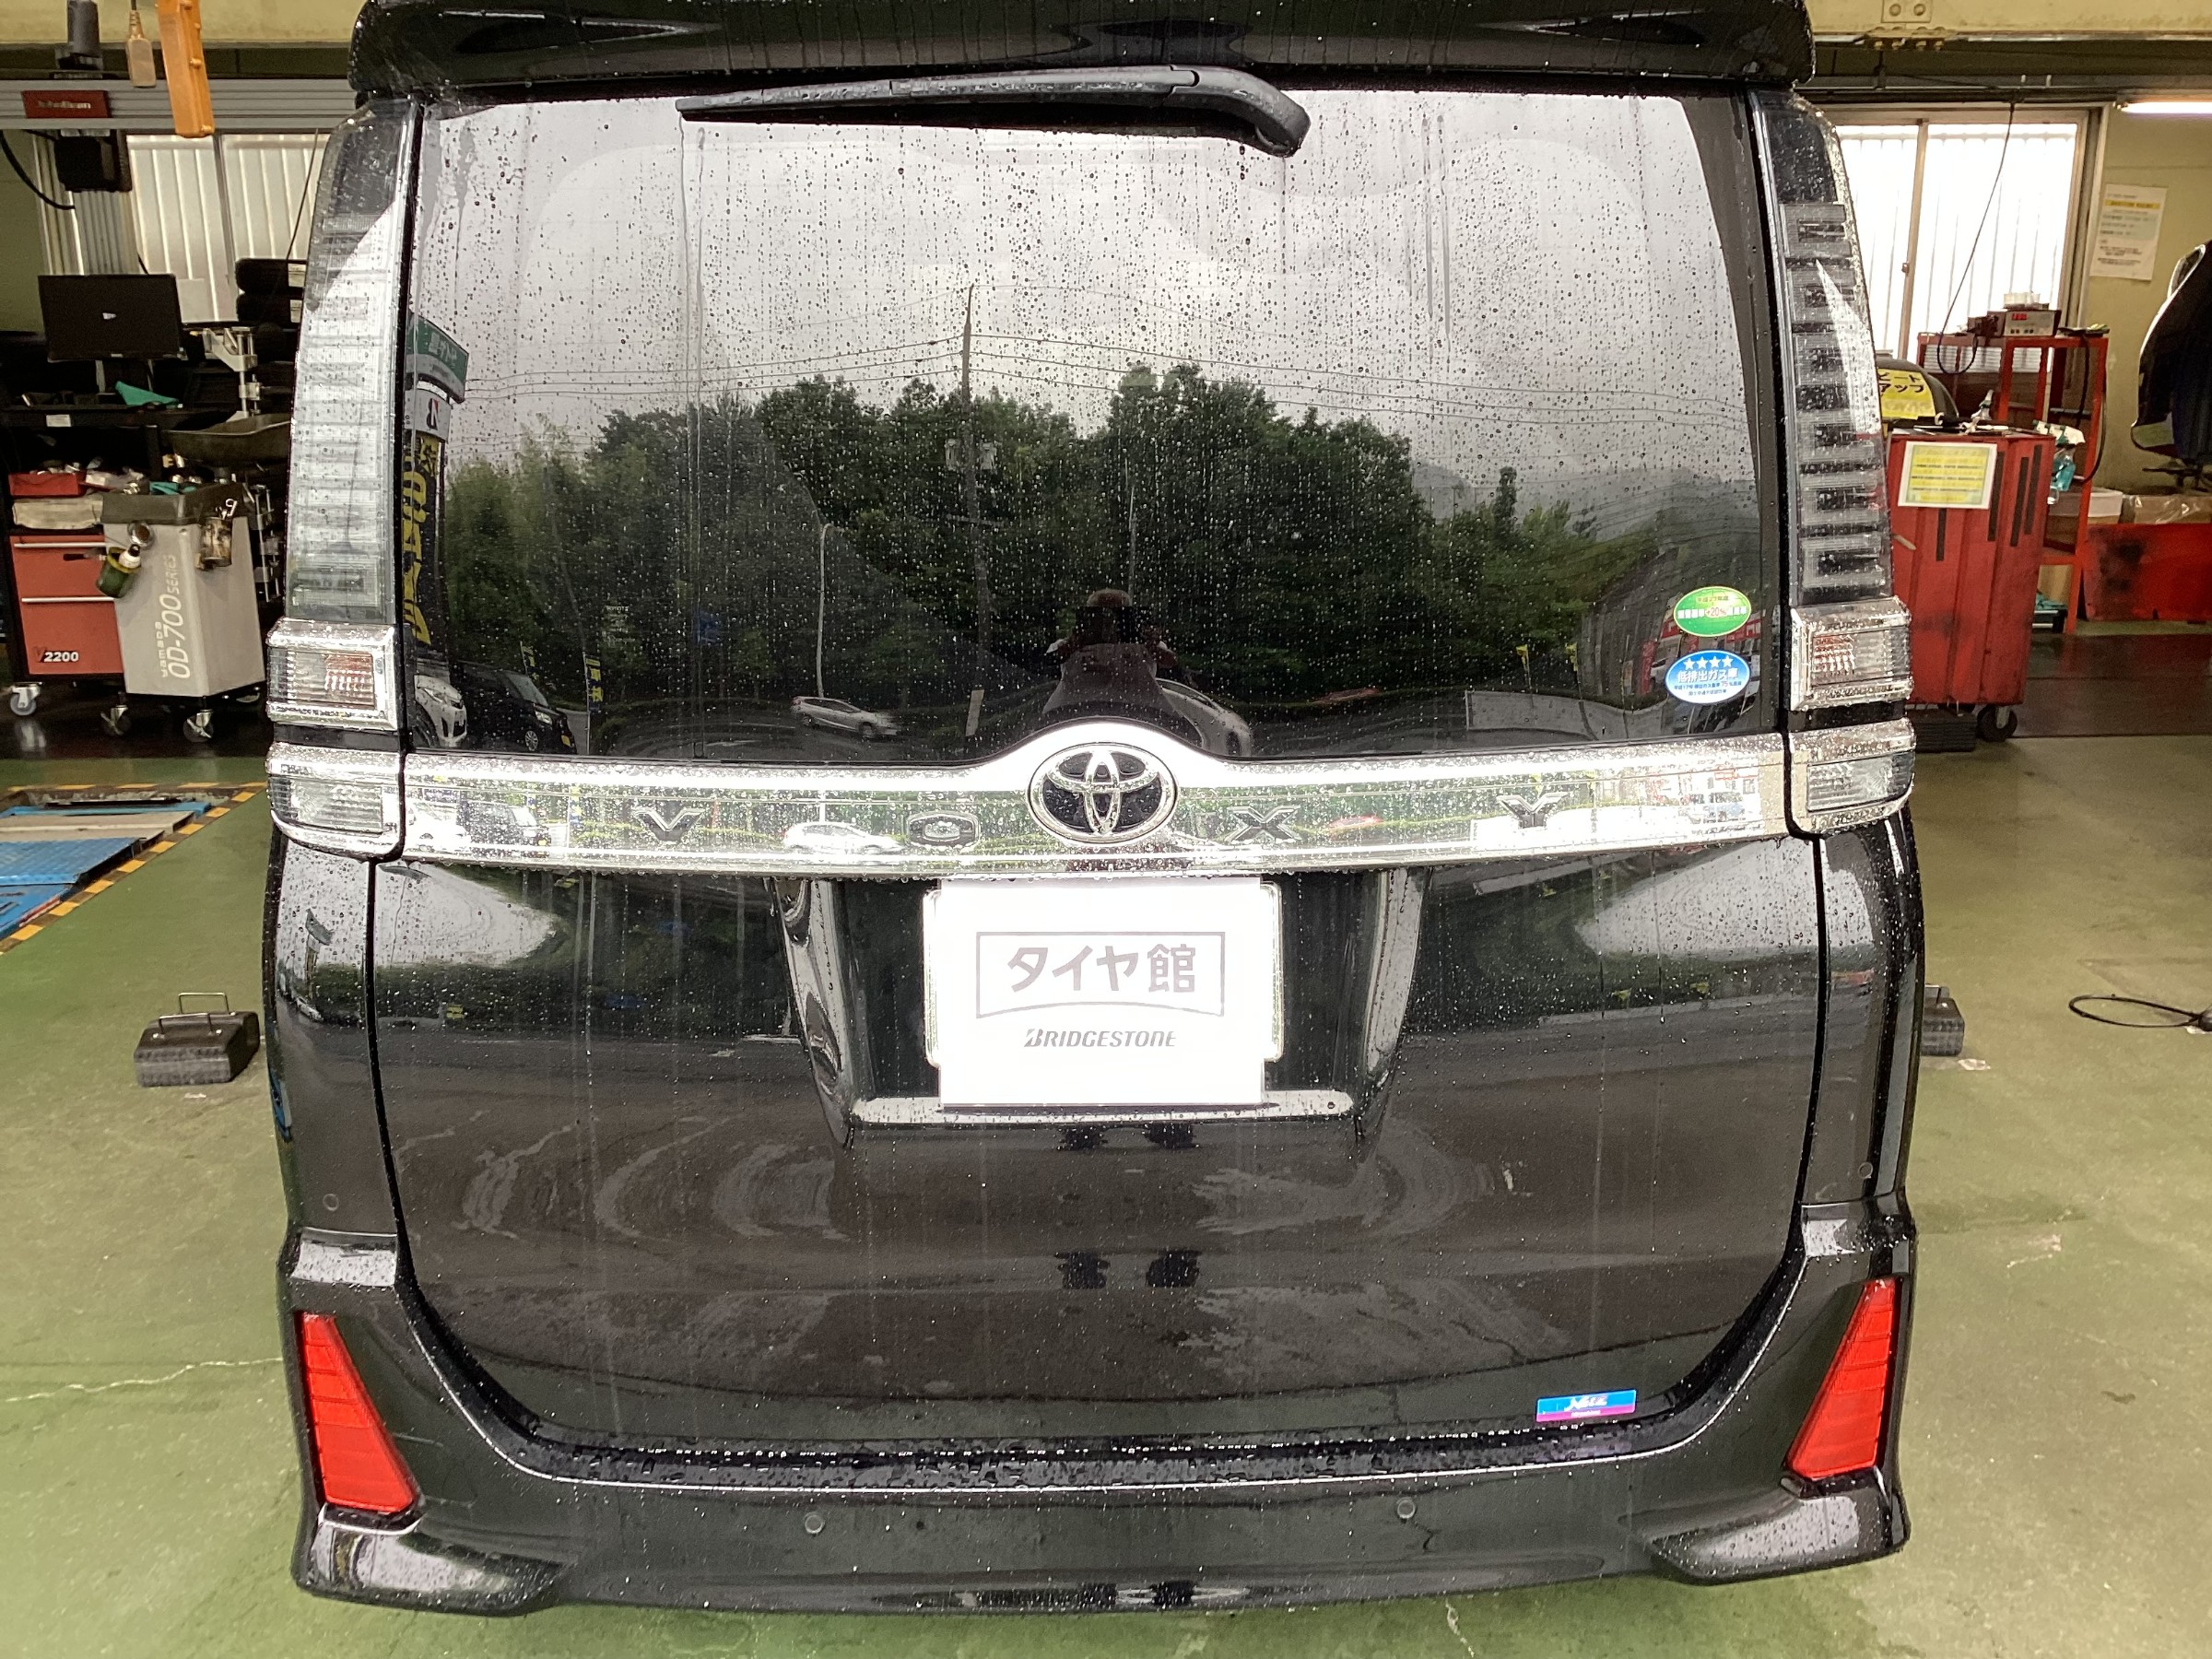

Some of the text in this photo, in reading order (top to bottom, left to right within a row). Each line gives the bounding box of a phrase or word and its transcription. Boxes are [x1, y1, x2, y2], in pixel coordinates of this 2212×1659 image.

[159, 594, 191, 678] OD-700
[1007, 943, 1196, 993] タイヤ館
[1023, 1028, 1177, 1048] BRIDGESTONE
